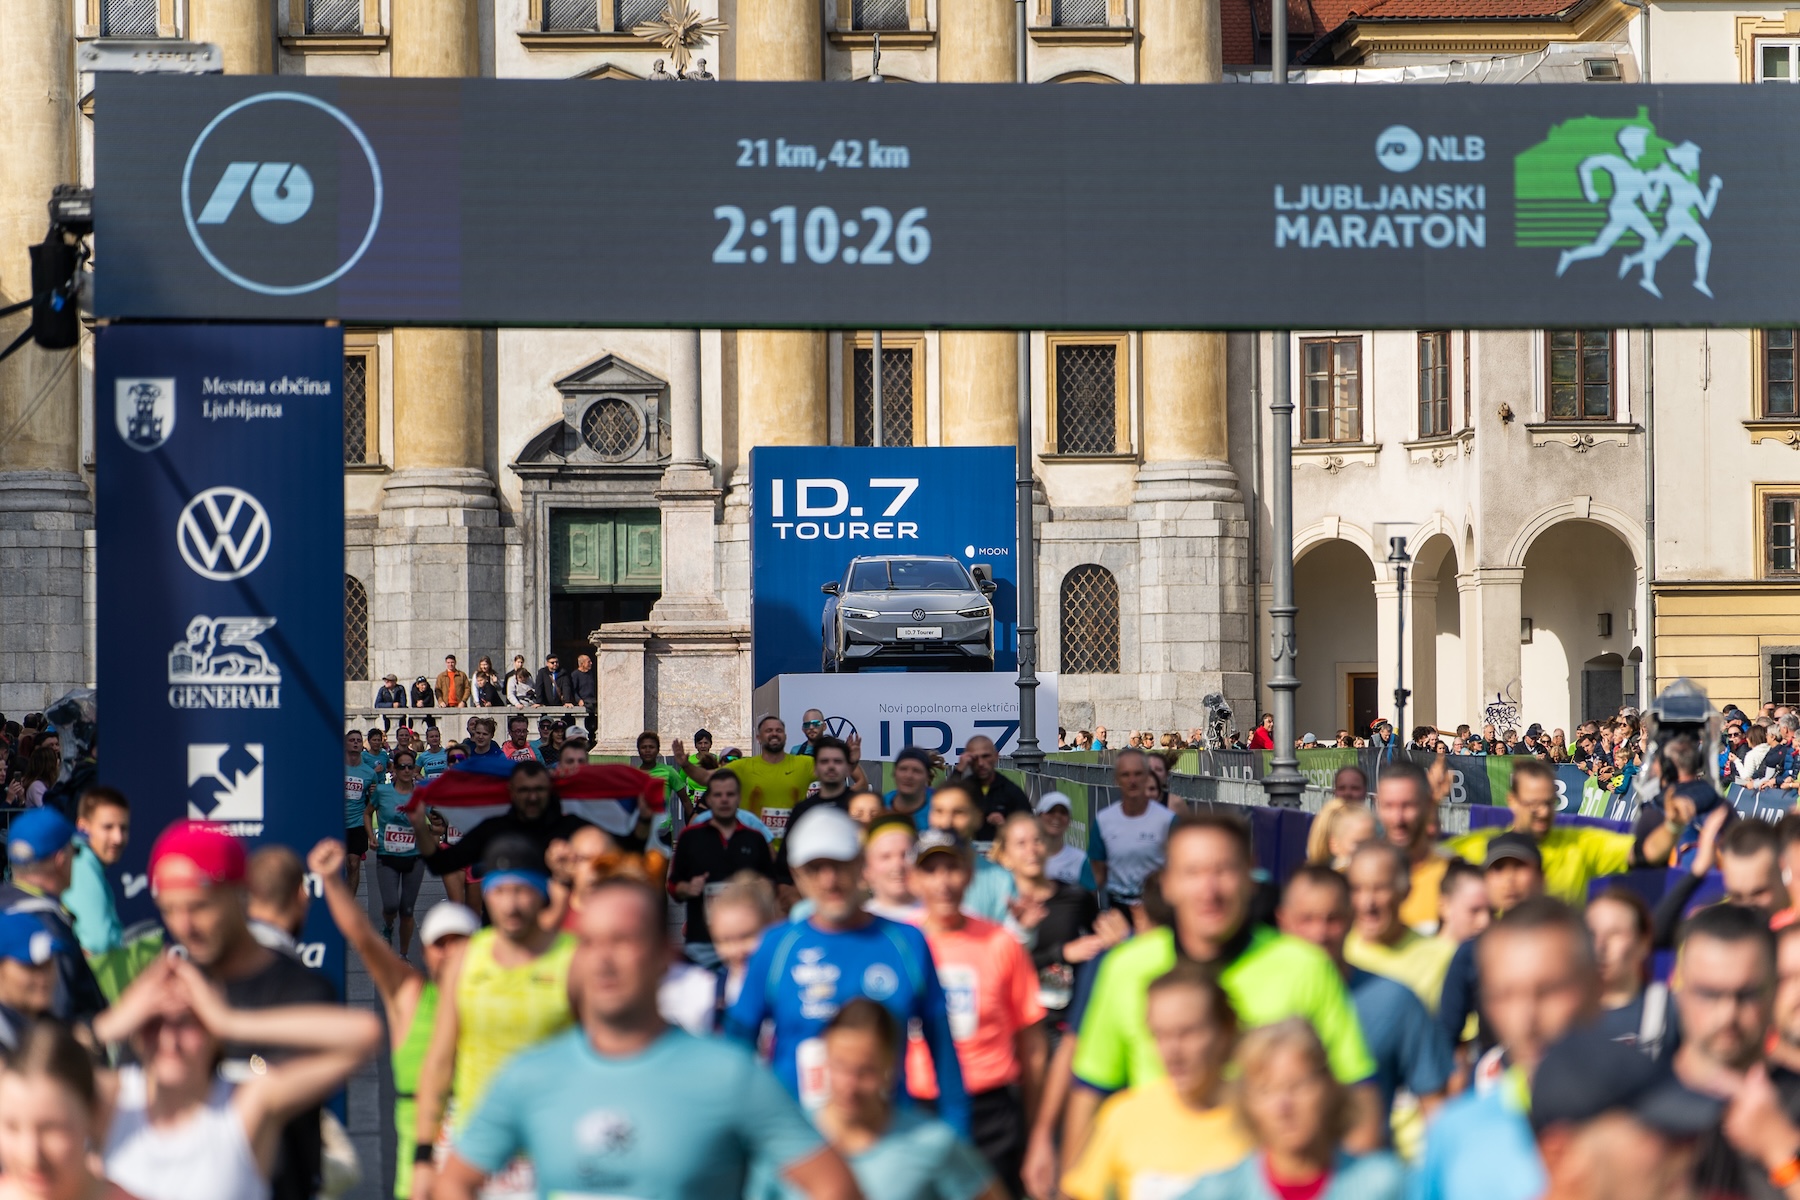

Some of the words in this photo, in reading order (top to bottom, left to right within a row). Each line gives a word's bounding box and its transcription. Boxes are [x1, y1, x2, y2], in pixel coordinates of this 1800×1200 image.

[736, 138, 769, 167] 21
[868, 138, 910, 168] km
[1427, 135, 1486, 162] NLB
[1274, 184, 1486, 211] LJUBLJANSKI
[712, 205, 931, 265] 2:10:26
[1275, 213, 1486, 248] MARATON
[202, 376, 266, 395] Mestna
[269, 376, 331, 396] občina
[202, 399, 283, 422] Ljubljana
[771, 477, 920, 518] ID.7
[771, 522, 919, 540] TOURER
[978, 547, 1009, 556] MOON
[168, 685, 281, 708] GENERALI
[879, 703, 903, 713] Novi
[906, 703, 968, 715] popolnoma
[970, 702, 1019, 713] električni
[390, 832, 414, 844] C4377
